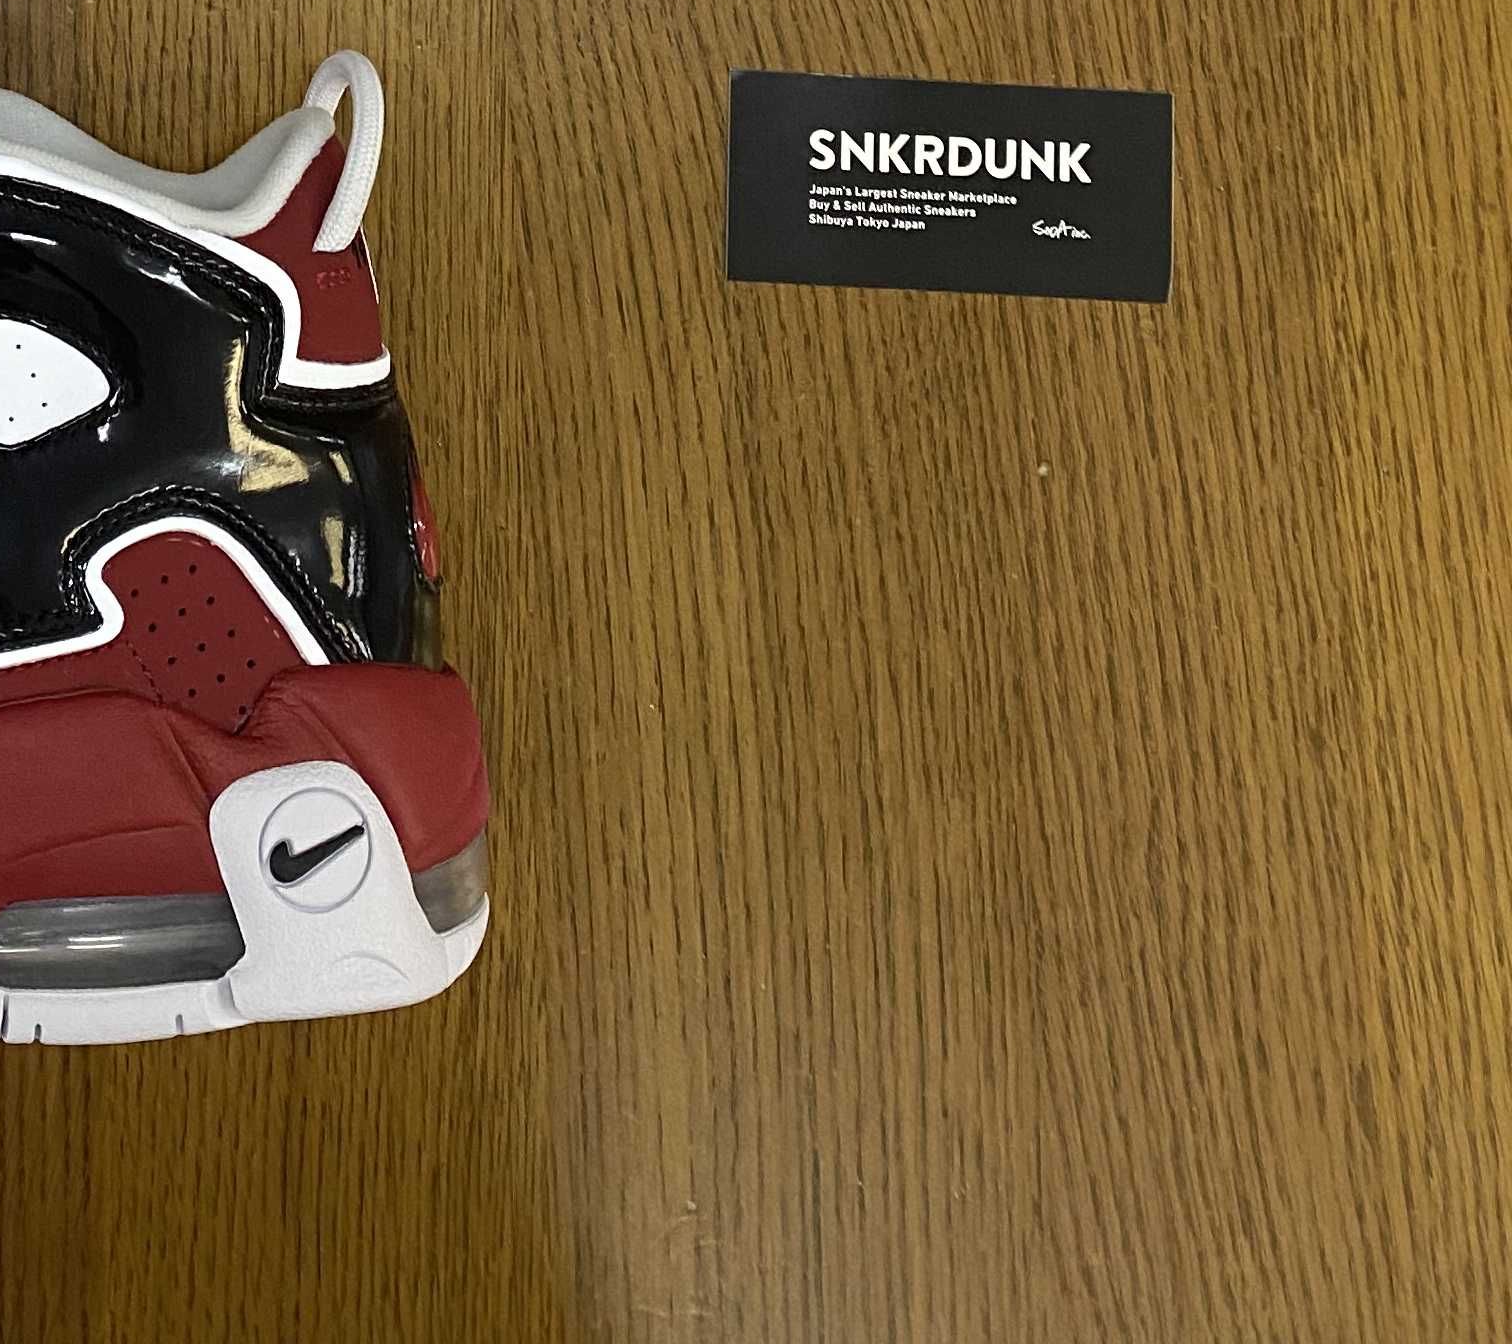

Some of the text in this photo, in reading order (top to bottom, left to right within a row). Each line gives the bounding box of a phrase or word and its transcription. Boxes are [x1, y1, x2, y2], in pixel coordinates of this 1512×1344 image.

[808, 128, 1091, 184] SNKRDUNK
[808, 184, 1018, 205] Japan's Largest Sneaker Marketplace
[808, 198, 977, 218] Buy & Sell Authentic Sneakers
[808, 213, 926, 231] Shibuya Tokyo Japan
